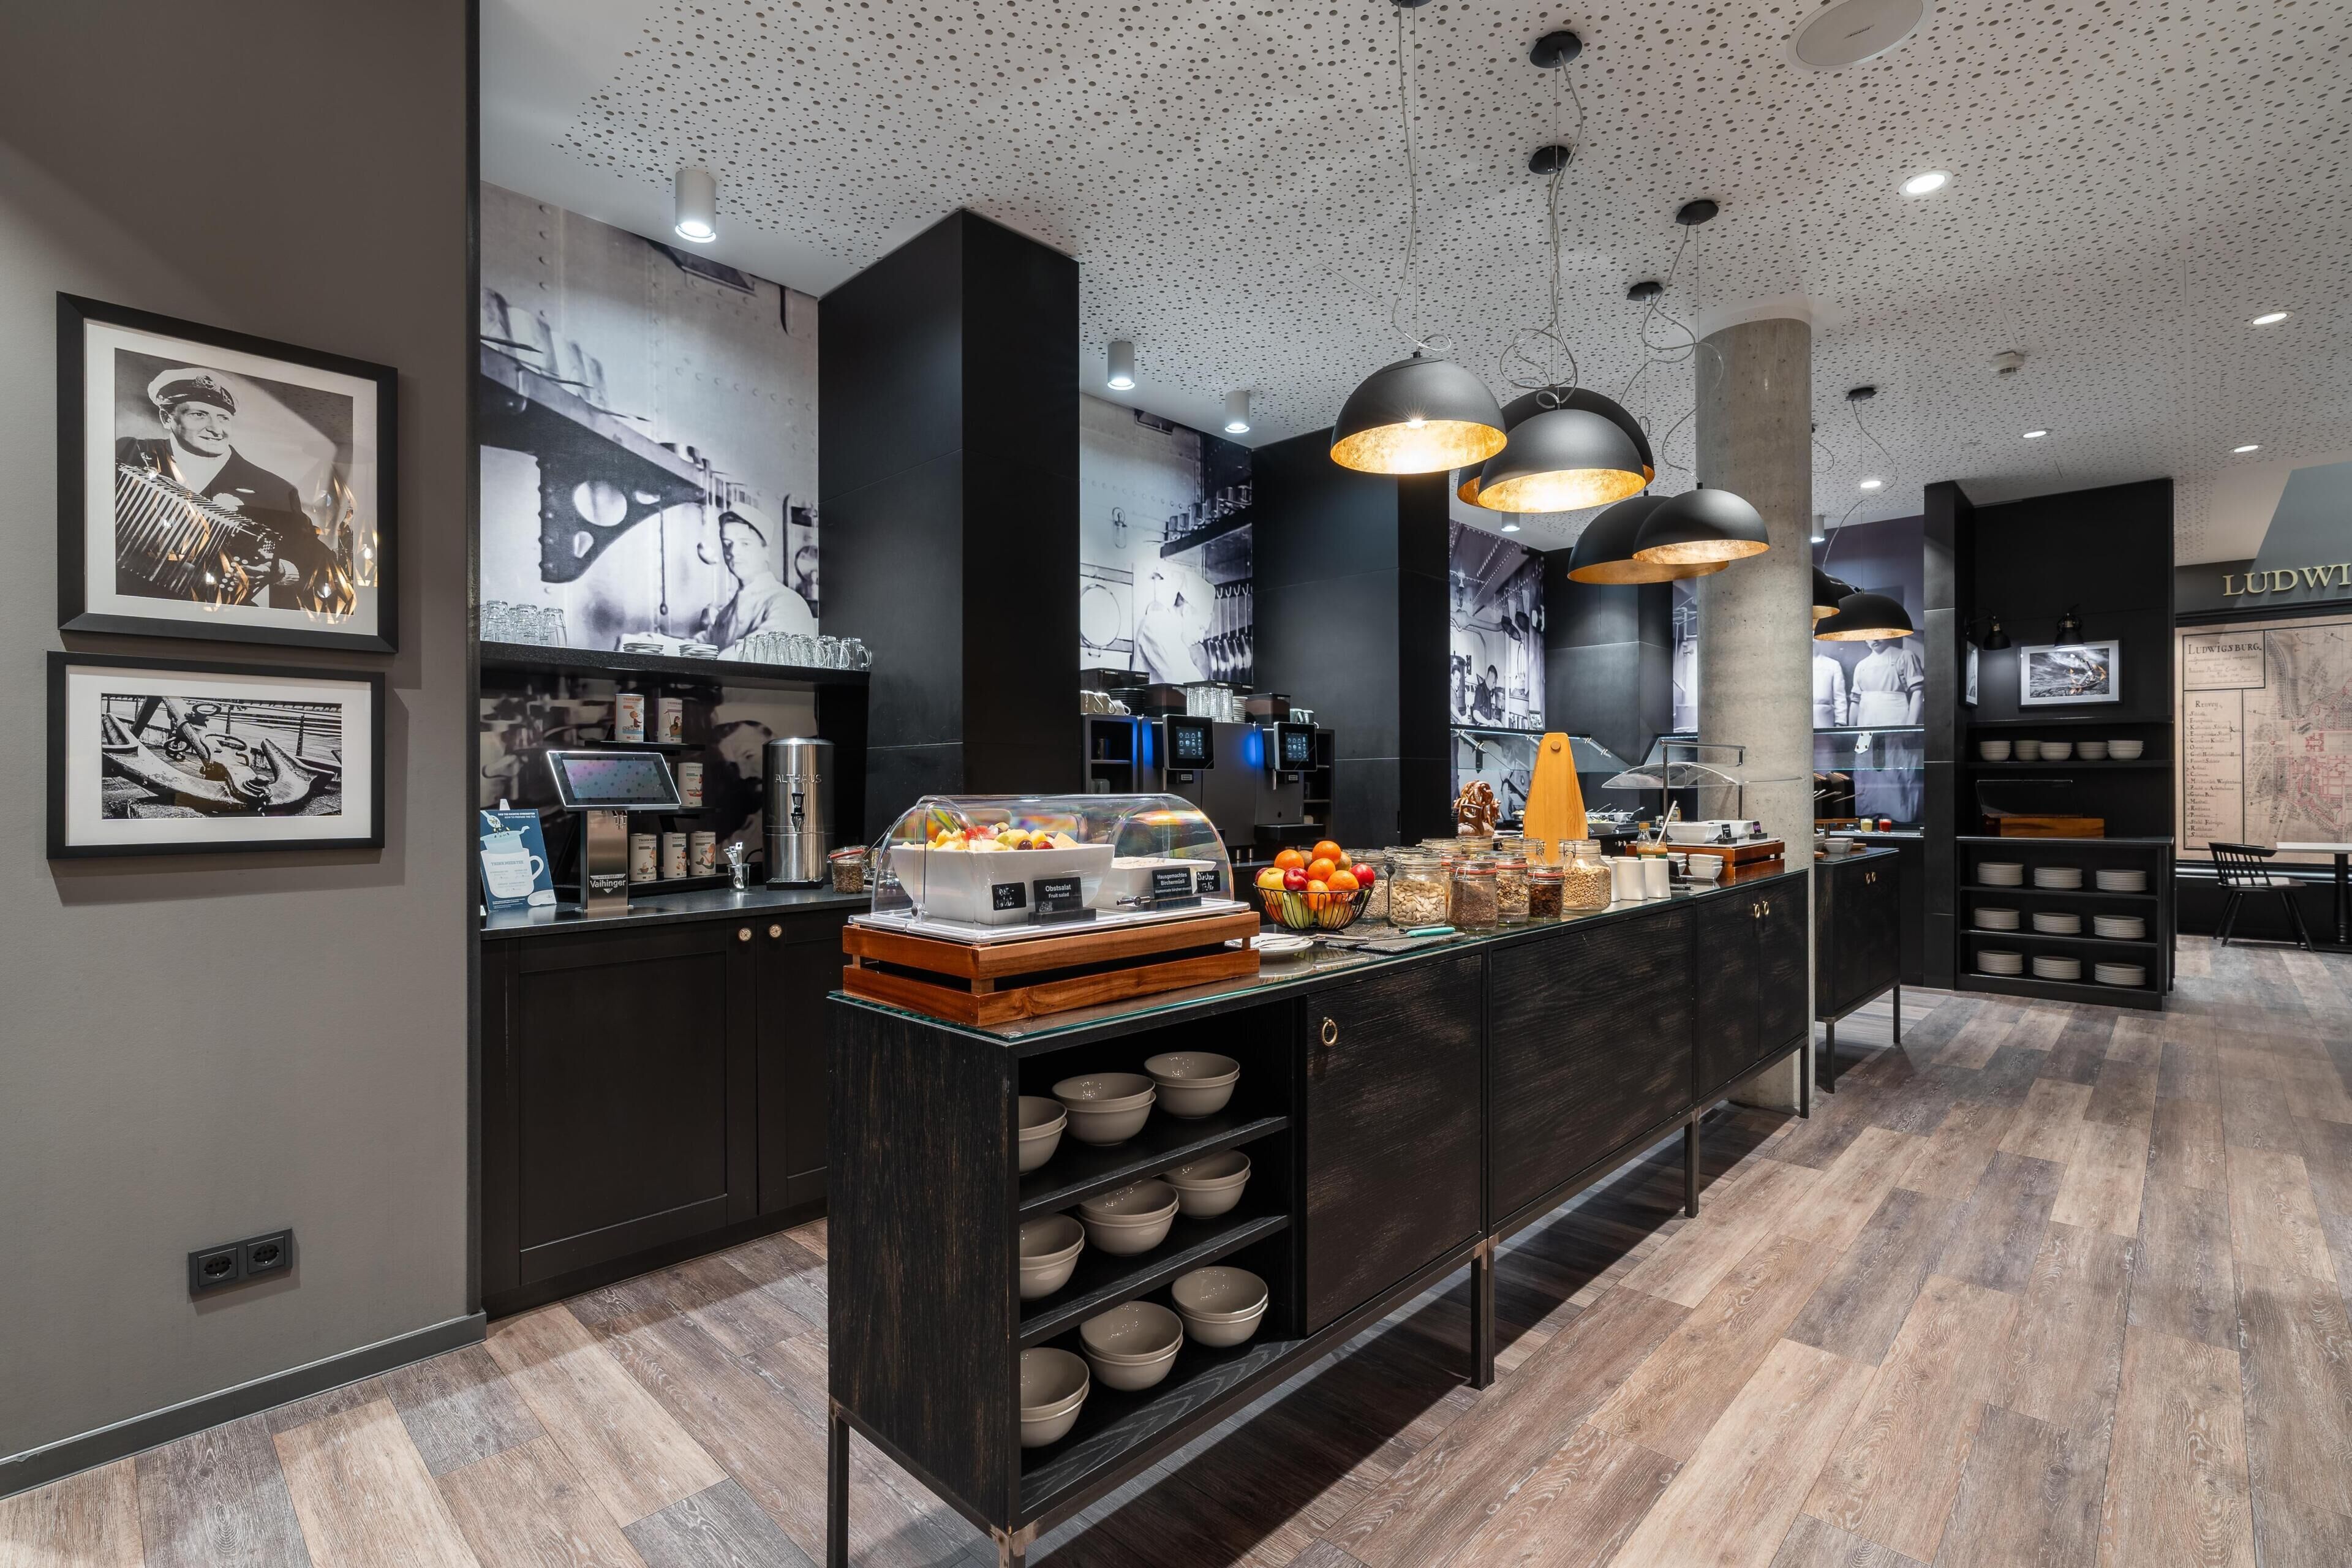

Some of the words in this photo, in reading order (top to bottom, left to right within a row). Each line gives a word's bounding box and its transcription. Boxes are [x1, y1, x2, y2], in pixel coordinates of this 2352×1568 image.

[2222, 563, 2352, 596] LUDWI
[775, 774, 822, 783] ALTHAUS
[590, 879, 626, 888] Vaihinger
